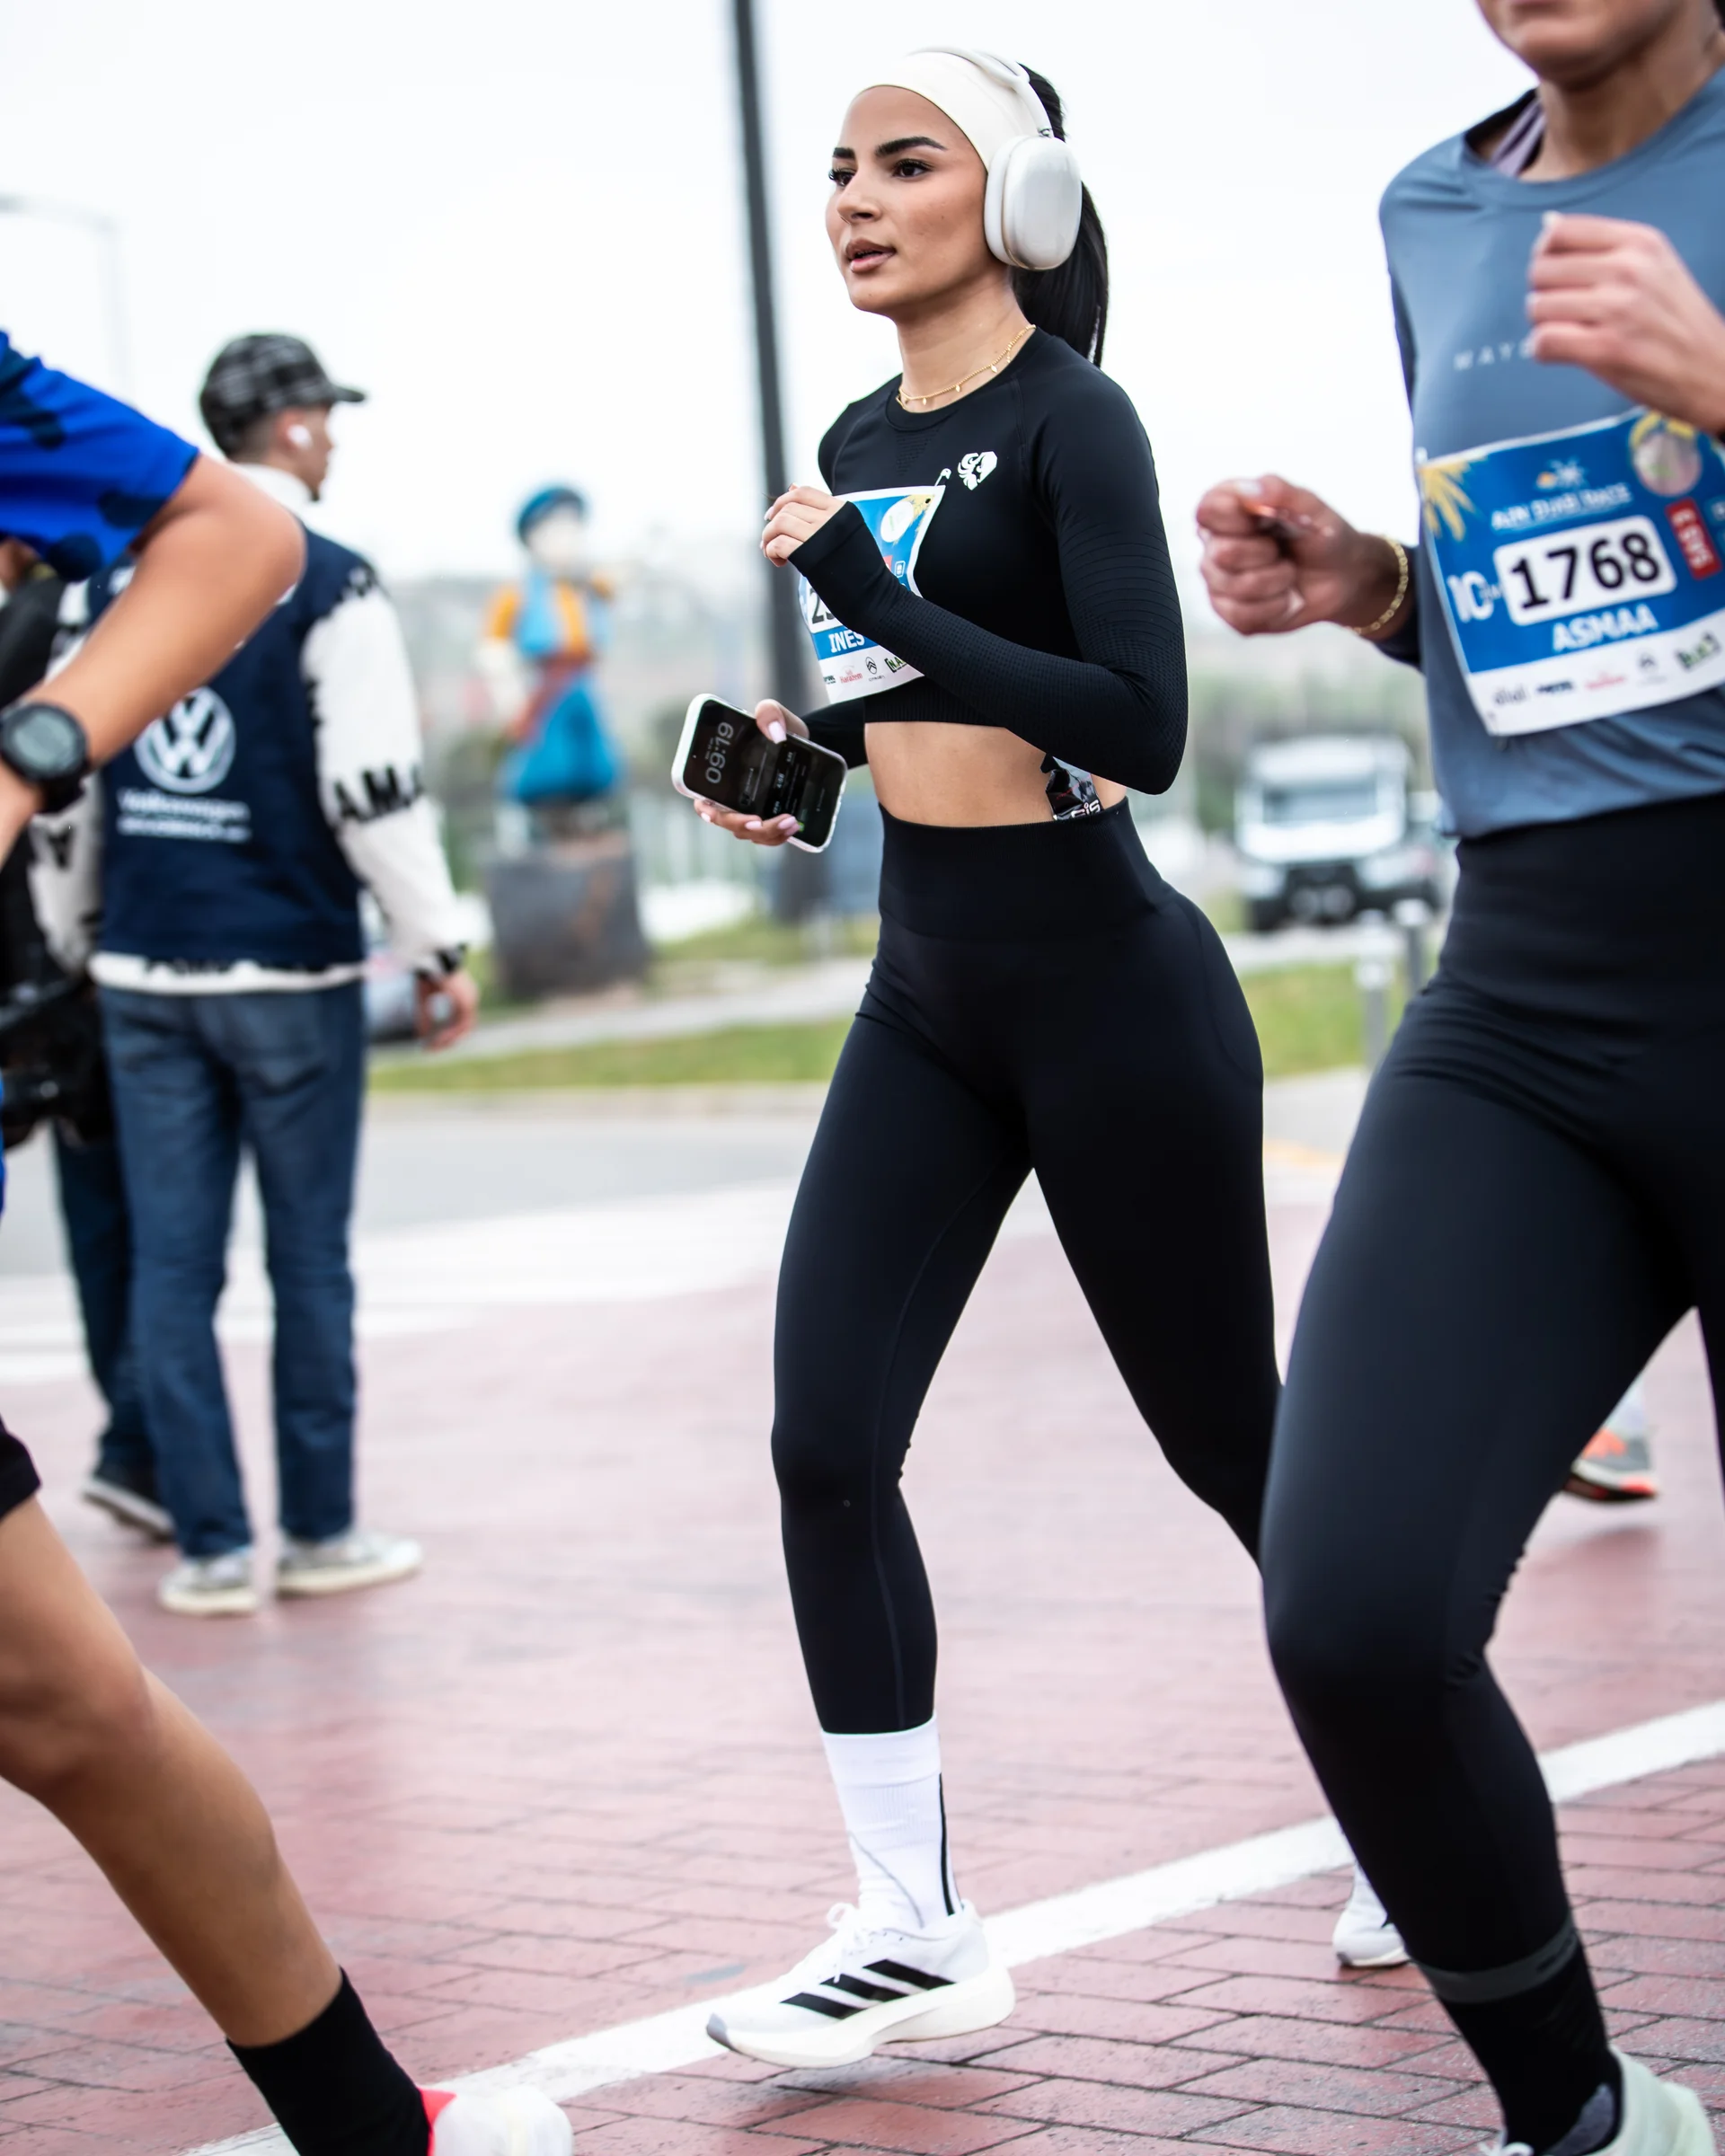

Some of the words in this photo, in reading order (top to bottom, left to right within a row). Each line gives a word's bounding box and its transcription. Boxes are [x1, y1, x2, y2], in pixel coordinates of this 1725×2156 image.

[1511, 533, 1659, 609] 1768
[828, 631, 865, 653] INES
[1552, 603, 1659, 653] ASMAA
[705, 722, 734, 784] 09:19
